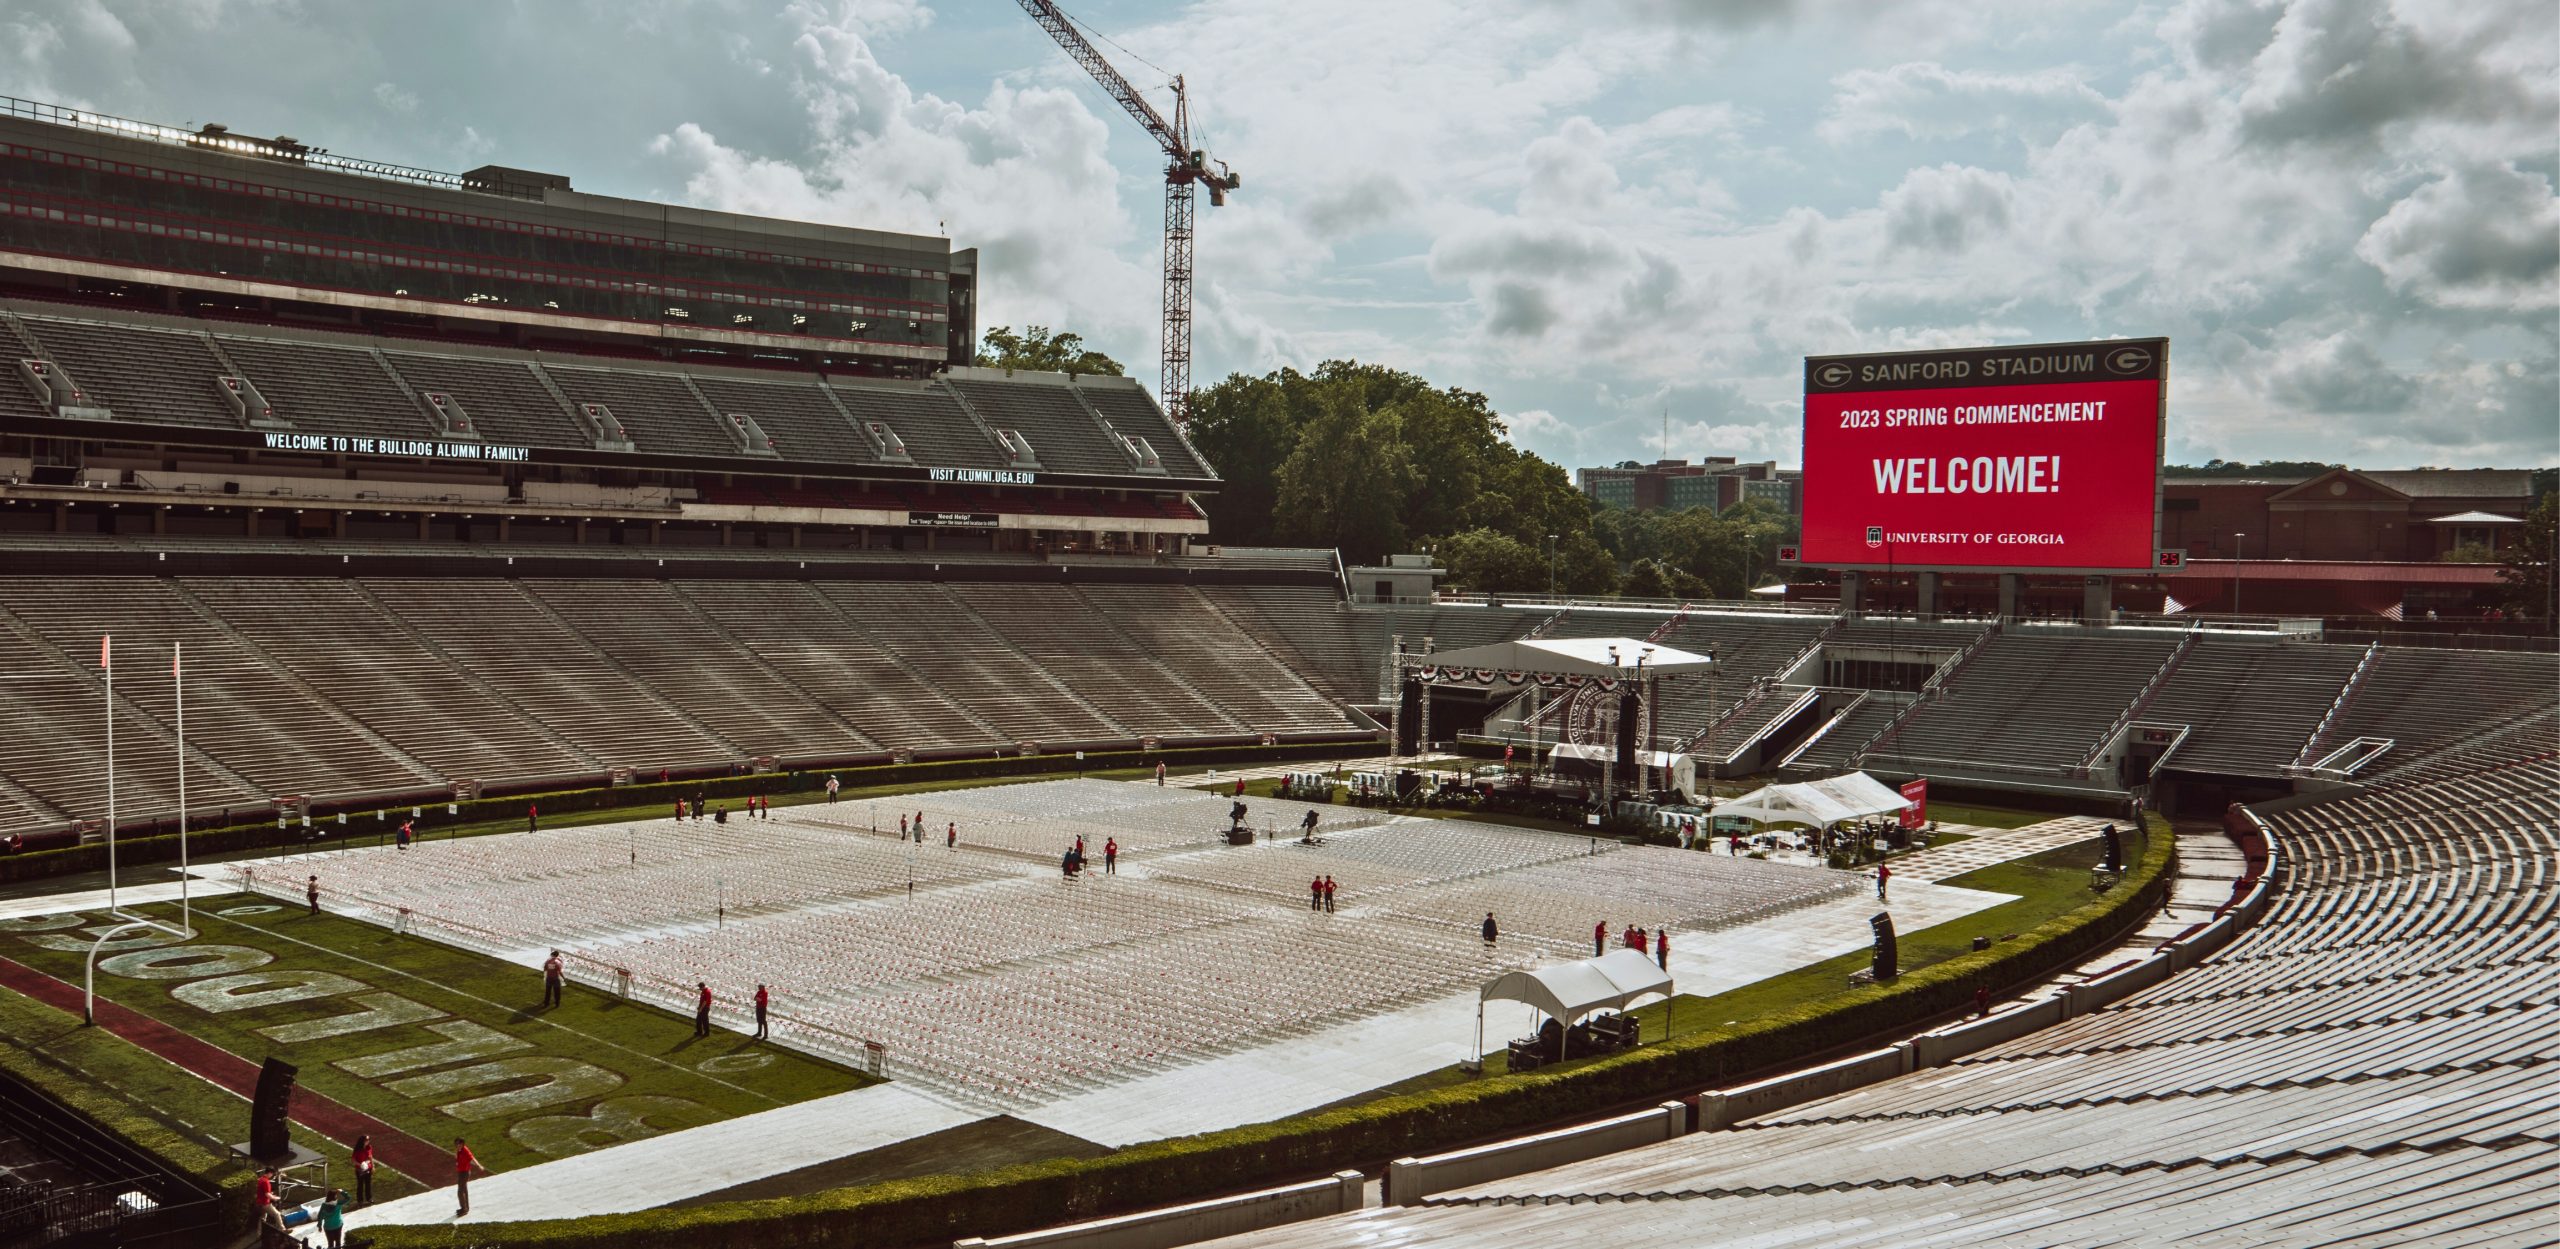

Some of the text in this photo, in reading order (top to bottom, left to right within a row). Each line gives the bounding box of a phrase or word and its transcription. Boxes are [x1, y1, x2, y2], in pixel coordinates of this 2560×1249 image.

[1862, 354, 2094, 382] SANFORD STADIUM
[1840, 402, 2107, 428] 2023 SPRING COMMENCEMENT
[265, 433, 529, 461] WELCOME TO THE BULLDOG ALUMNI FAMILY!
[930, 468, 1035, 484] VISIT ALUMNI.UGA.EDU
[1872, 455, 2060, 494] WELCOME!
[1886, 532, 2065, 545] UNIVERSITY OF GEORGIA
[2161, 553, 2178, 565] 25
